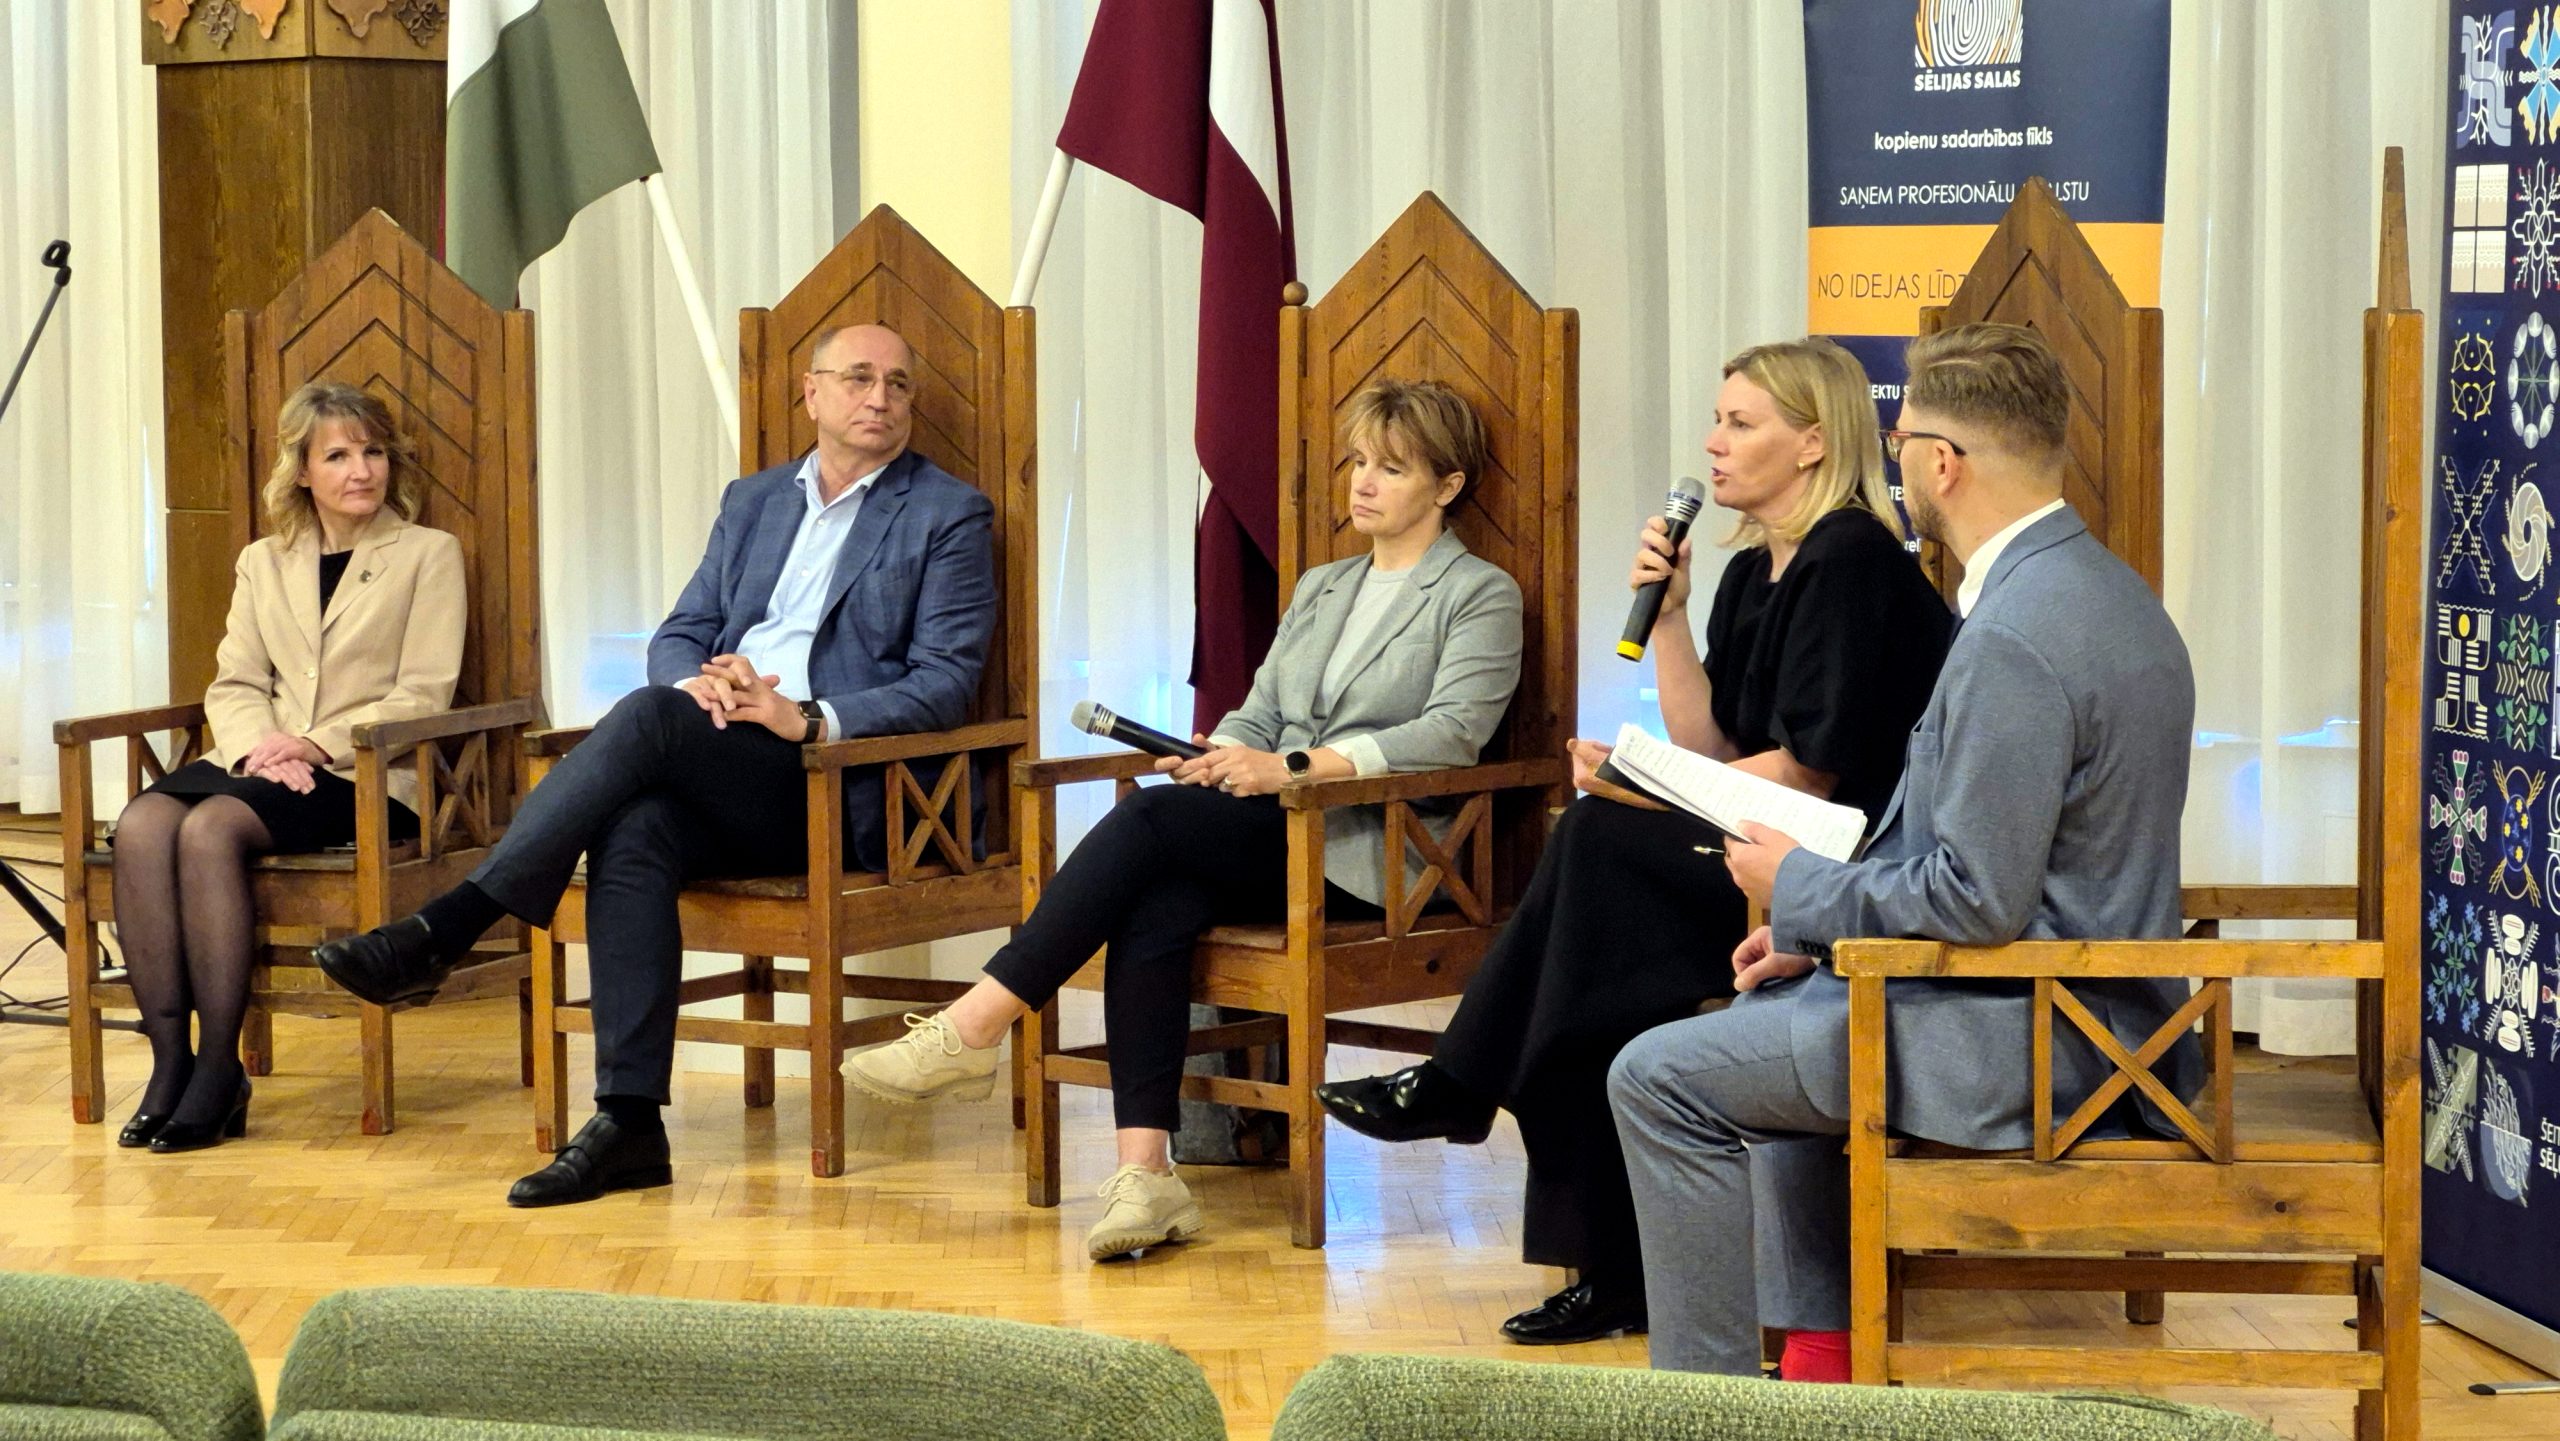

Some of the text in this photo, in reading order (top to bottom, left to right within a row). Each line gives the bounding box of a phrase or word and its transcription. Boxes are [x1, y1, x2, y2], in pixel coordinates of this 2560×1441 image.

[1914, 69, 2021, 92] SĒLIJAS SALAS
[1874, 131, 1938, 153] kopienu
[1941, 128, 2023, 148] sadarbības
[1840, 185, 1893, 208] SAŅEM
[1898, 181, 2015, 204] PROFESIONĀLU
[1818, 273, 1844, 298] NO
[1850, 273, 1920, 298] IDEJAS
